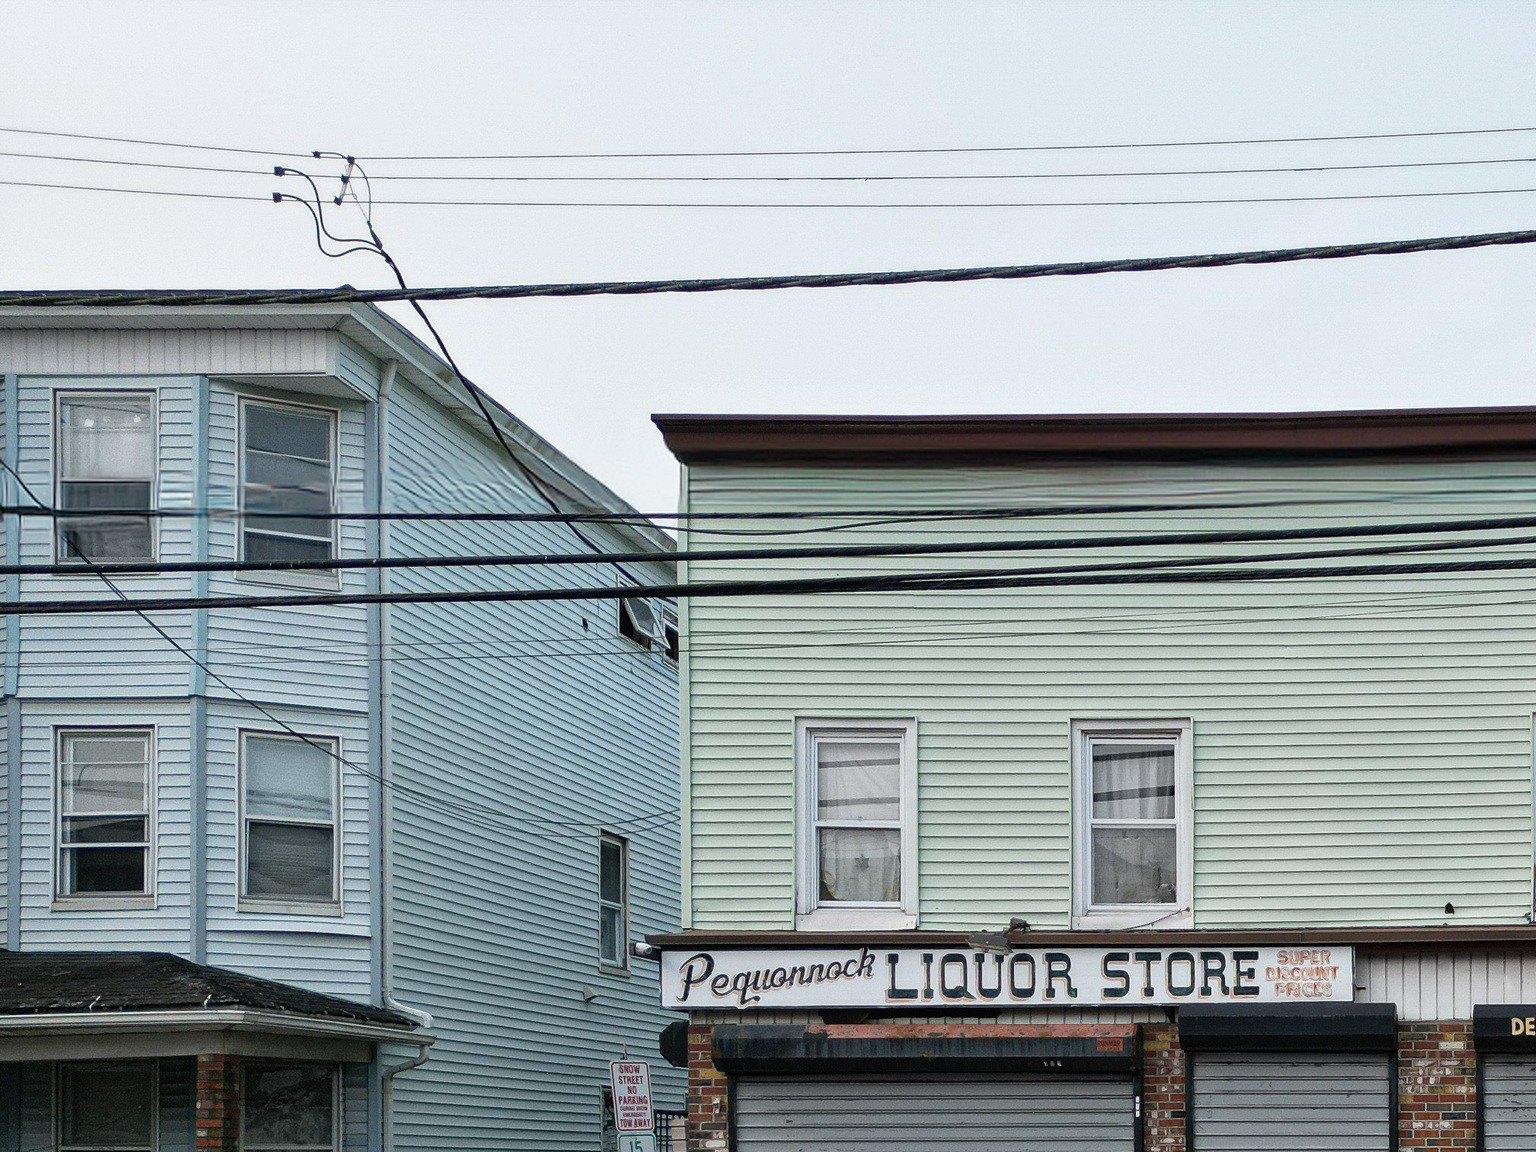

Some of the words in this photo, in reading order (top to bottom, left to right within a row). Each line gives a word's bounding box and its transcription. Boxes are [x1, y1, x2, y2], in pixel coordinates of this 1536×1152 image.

[1276, 949, 1331, 966] SUPER
[675, 946, 876, 1008] Pequonnock
[885, 952, 1079, 1003] LIQUOR
[1101, 951, 1260, 1000] STORE
[1265, 965, 1340, 982] DISCOUNT
[619, 1064, 641, 1074] SNOW
[618, 1075, 644, 1085] STREET
[627, 1085, 638, 1095] NO
[618, 1095, 648, 1105] PARKING
[633, 1118, 651, 1128] AWAY
